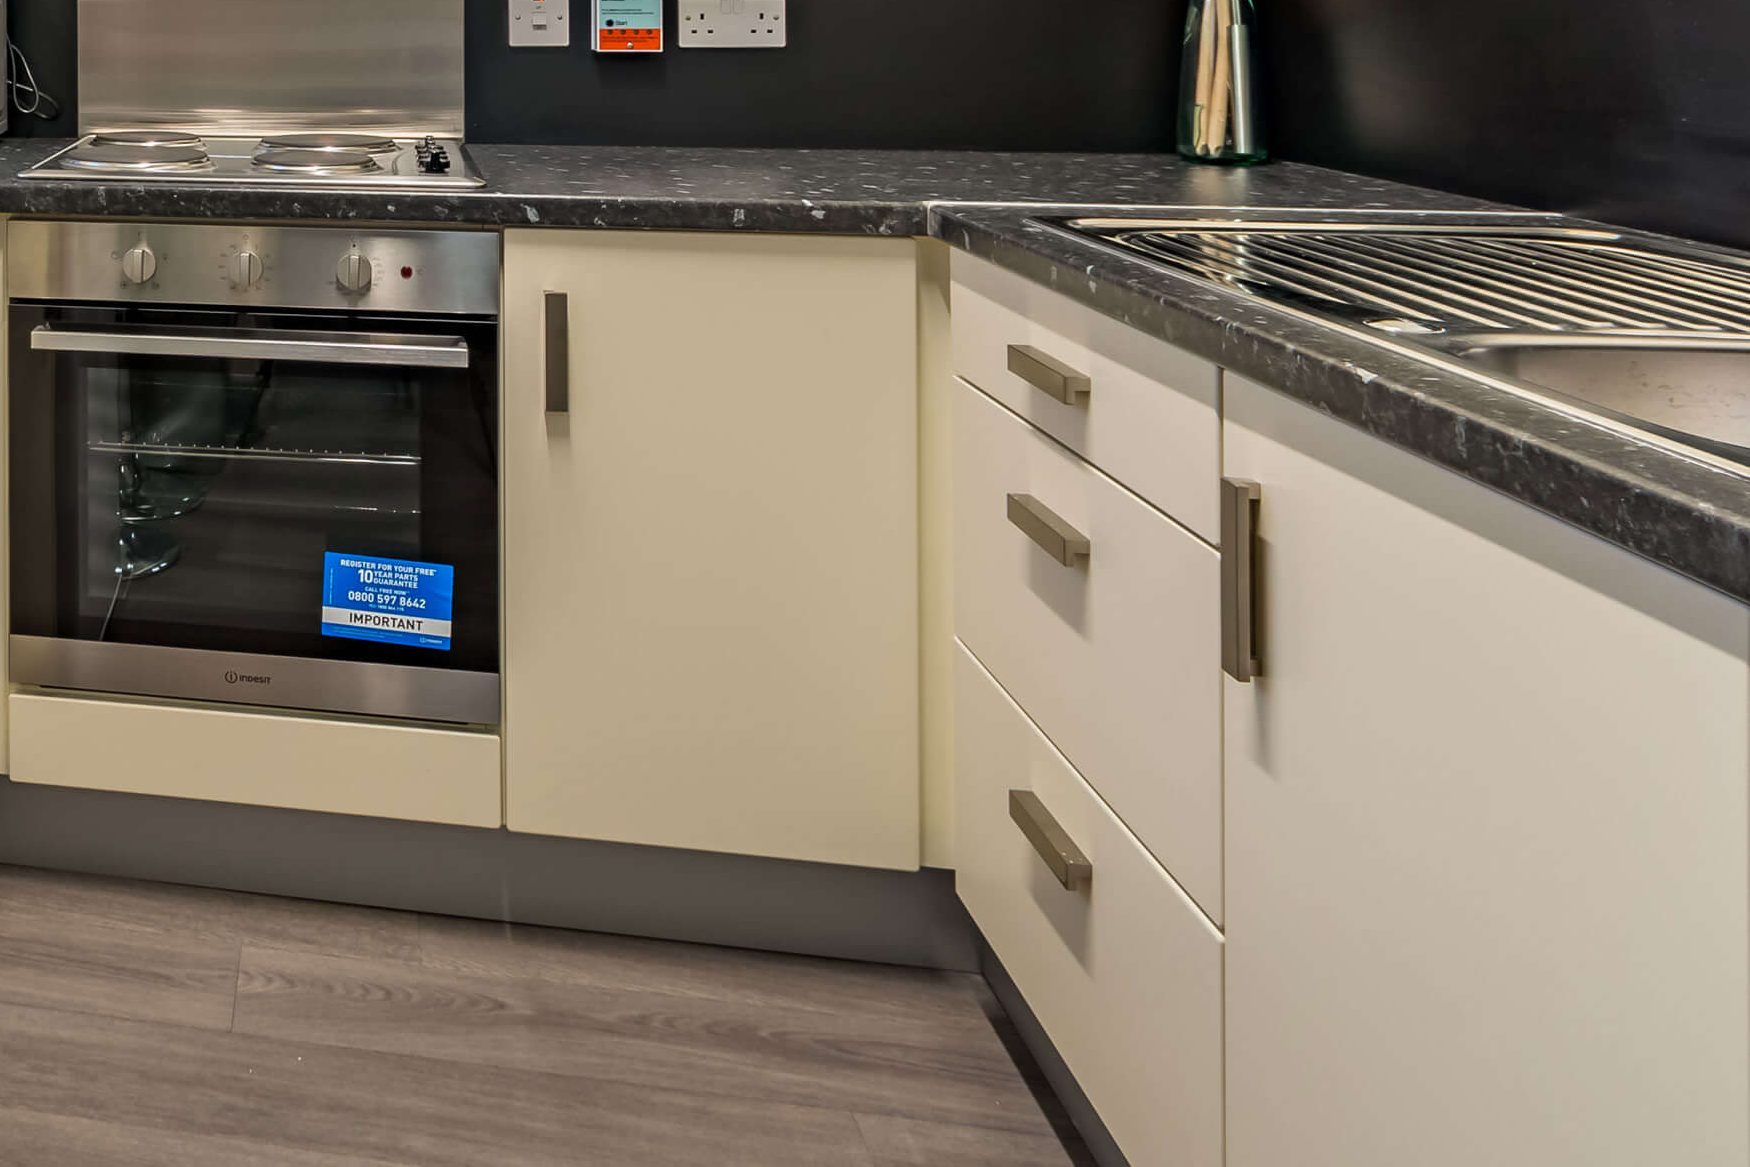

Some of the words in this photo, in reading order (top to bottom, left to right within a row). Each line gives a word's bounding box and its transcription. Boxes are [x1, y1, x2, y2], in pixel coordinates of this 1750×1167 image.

[340, 559, 376, 570] REGISTER
[377, 563, 393, 572] FOR
[393, 564, 415, 574] YOUR
[357, 568, 374, 583] 10
[373, 577, 419, 589] GUARANTEE
[374, 570, 393, 579] YEAR
[394, 573, 419, 582] PARTS
[348, 590, 375, 603] 0800
[377, 593, 397, 606] 597
[399, 596, 427, 609] 8642
[349, 612, 423, 630] IMPORTANT
